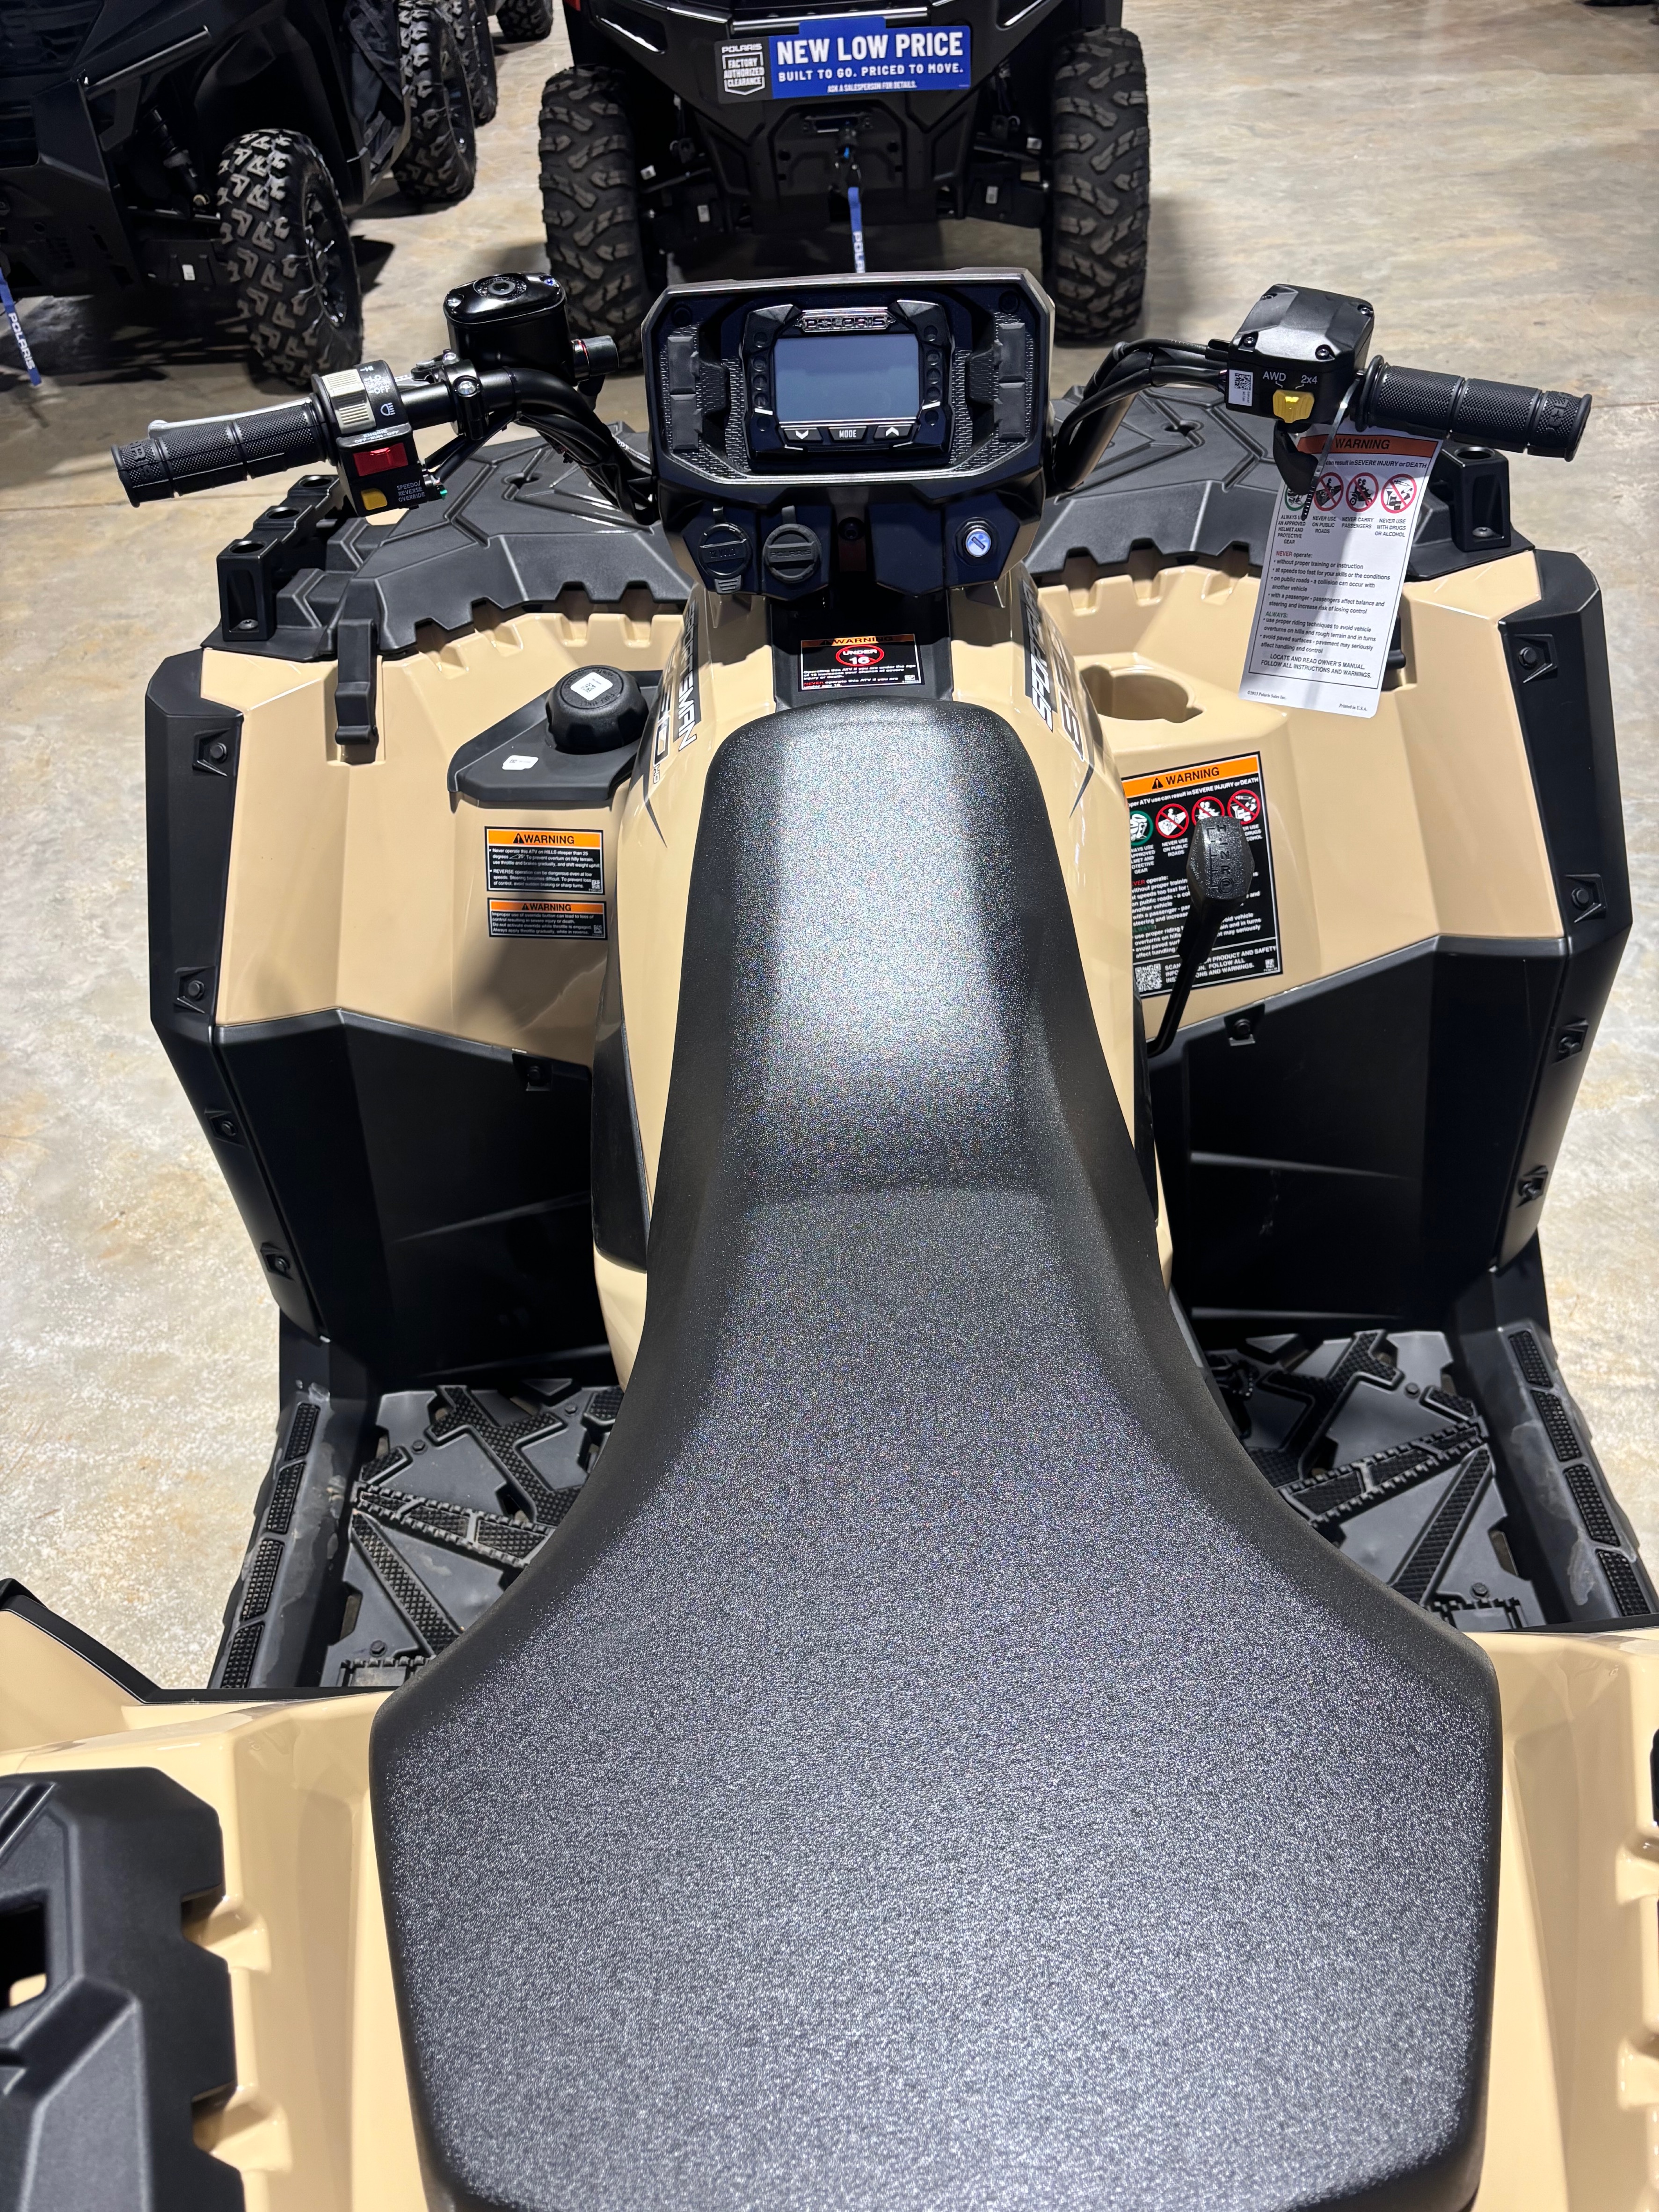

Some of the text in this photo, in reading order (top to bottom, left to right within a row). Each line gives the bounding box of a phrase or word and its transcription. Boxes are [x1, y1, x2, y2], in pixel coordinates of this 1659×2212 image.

[721, 43, 763, 53] POLARIS
[777, 32, 963, 65] NEW LOW PRICE
[728, 58, 758, 69] FACTORY
[724, 66, 765, 79] AUTHORIZED
[778, 63, 964, 82] BUILT TO GO. PRICED TO MOVE.
[727, 77, 762, 87] CLEARANCE
[827, 84, 838, 93] ASK
[844, 81, 881, 92] SALESPERSON
[804, 317, 885, 330] POLARIS
[8, 312, 36, 370] POLARIS
[1263, 371, 1317, 384] AWD 2x4
[374, 385, 390, 394] OFF
[363, 429, 388, 438] ENGINE
[839, 429, 857, 438] MODE
[1335, 439, 1390, 450] WARNING
[397, 480, 421, 491] SPEEDO/
[398, 486, 423, 496] REVERSE
[398, 492, 426, 502] OVERRIDE
[709, 548, 736, 558] 12 VOLT
[771, 549, 812, 558] POLARIS
[834, 636, 893, 645] WARNING
[849, 656, 870, 665] 16
[678, 599, 698, 752] SPORTSMAN
[1293, 664, 1330, 673] INSTRUCTIONS
[1343, 670, 1371, 678] WARNINGS.
[1165, 767, 1220, 785] WARNING
[1192, 785, 1214, 795] SEVERE
[1215, 782, 1234, 791] INJURY
[1240, 777, 1259, 786] DEATH
[524, 834, 575, 844] WARNING
[1220, 850, 1230, 860] N
[1221, 865, 1231, 875] R
[1212, 952, 1240, 963] PRODUCT
[1254, 945, 1277, 954] SAFETY
[1208, 961, 1233, 970] FOLLOW
[1222, 962, 1254, 973] WARNINGS.
